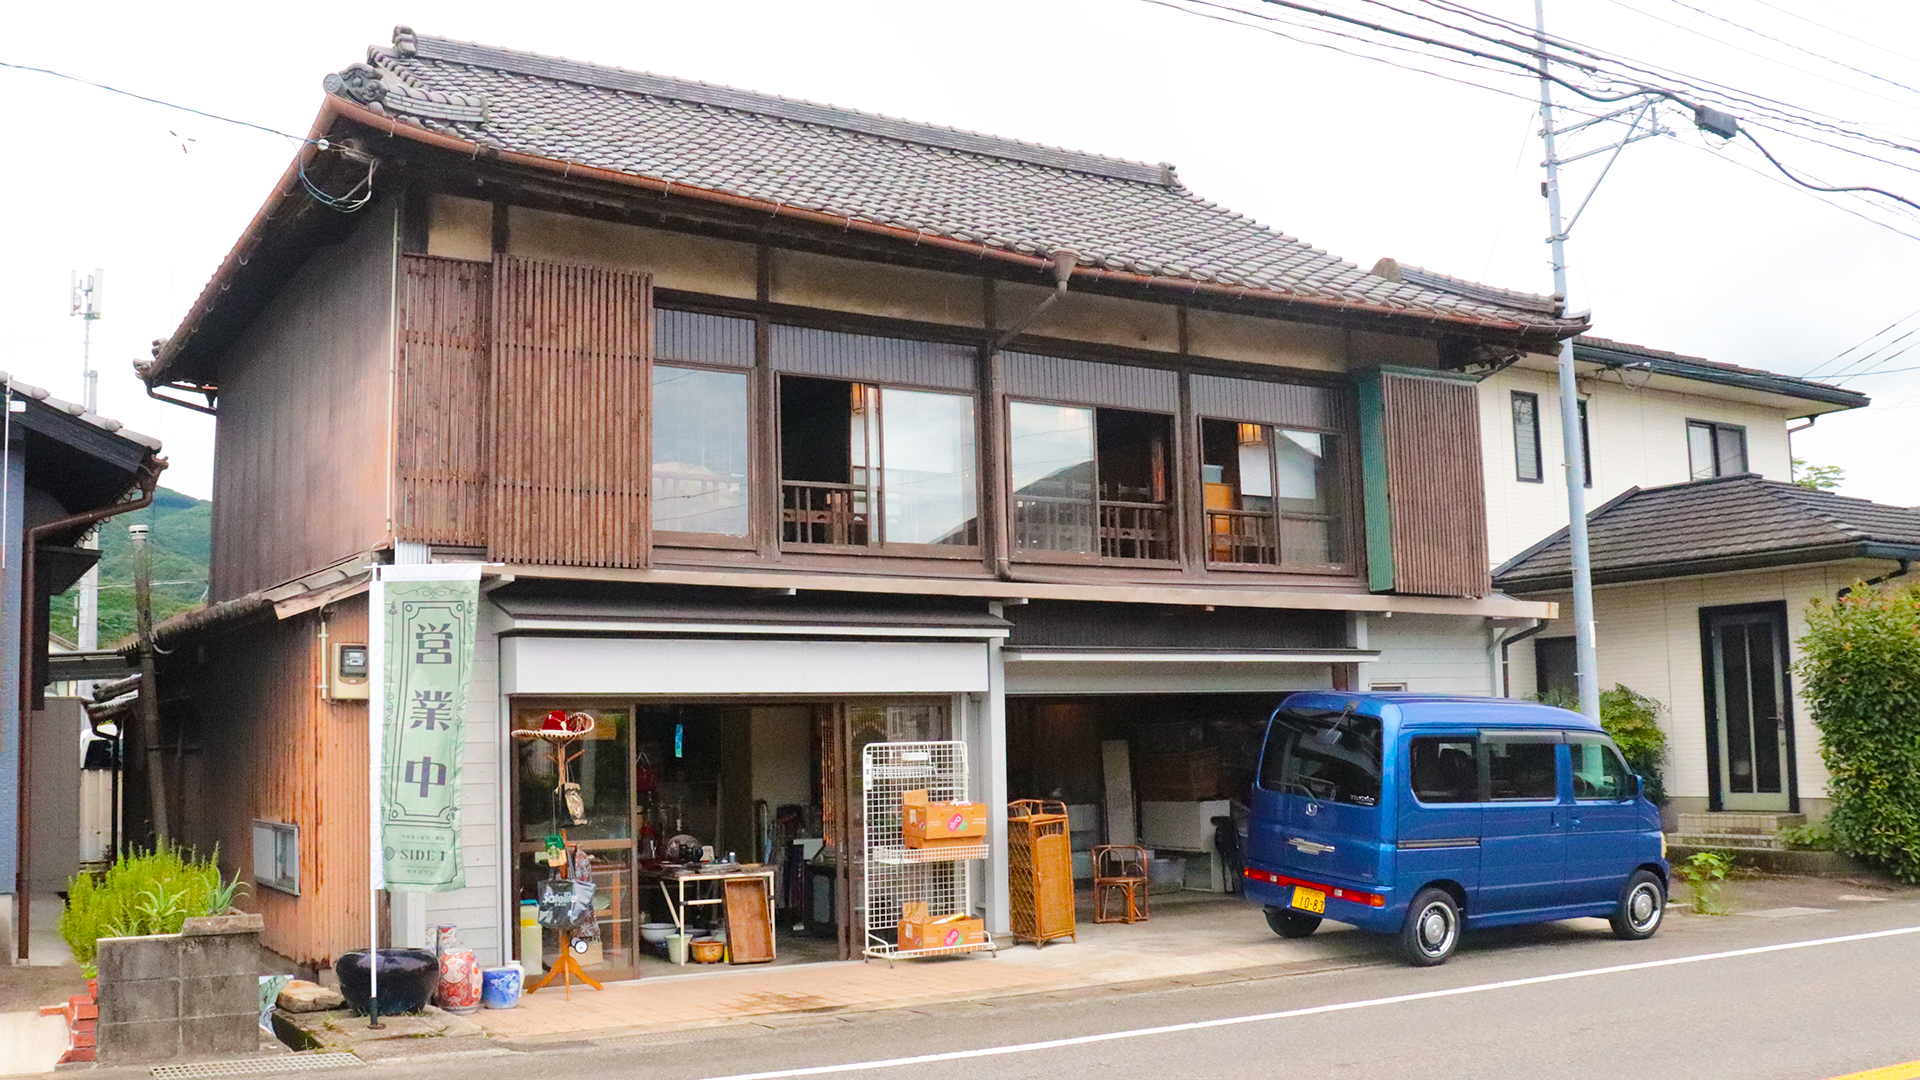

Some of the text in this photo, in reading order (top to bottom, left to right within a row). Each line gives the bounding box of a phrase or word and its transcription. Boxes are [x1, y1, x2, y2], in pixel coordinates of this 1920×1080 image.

[404, 623, 454, 798] 営業中
[400, 849, 435, 861] SIDE
[1299, 896, 1325, 912] 10-83
